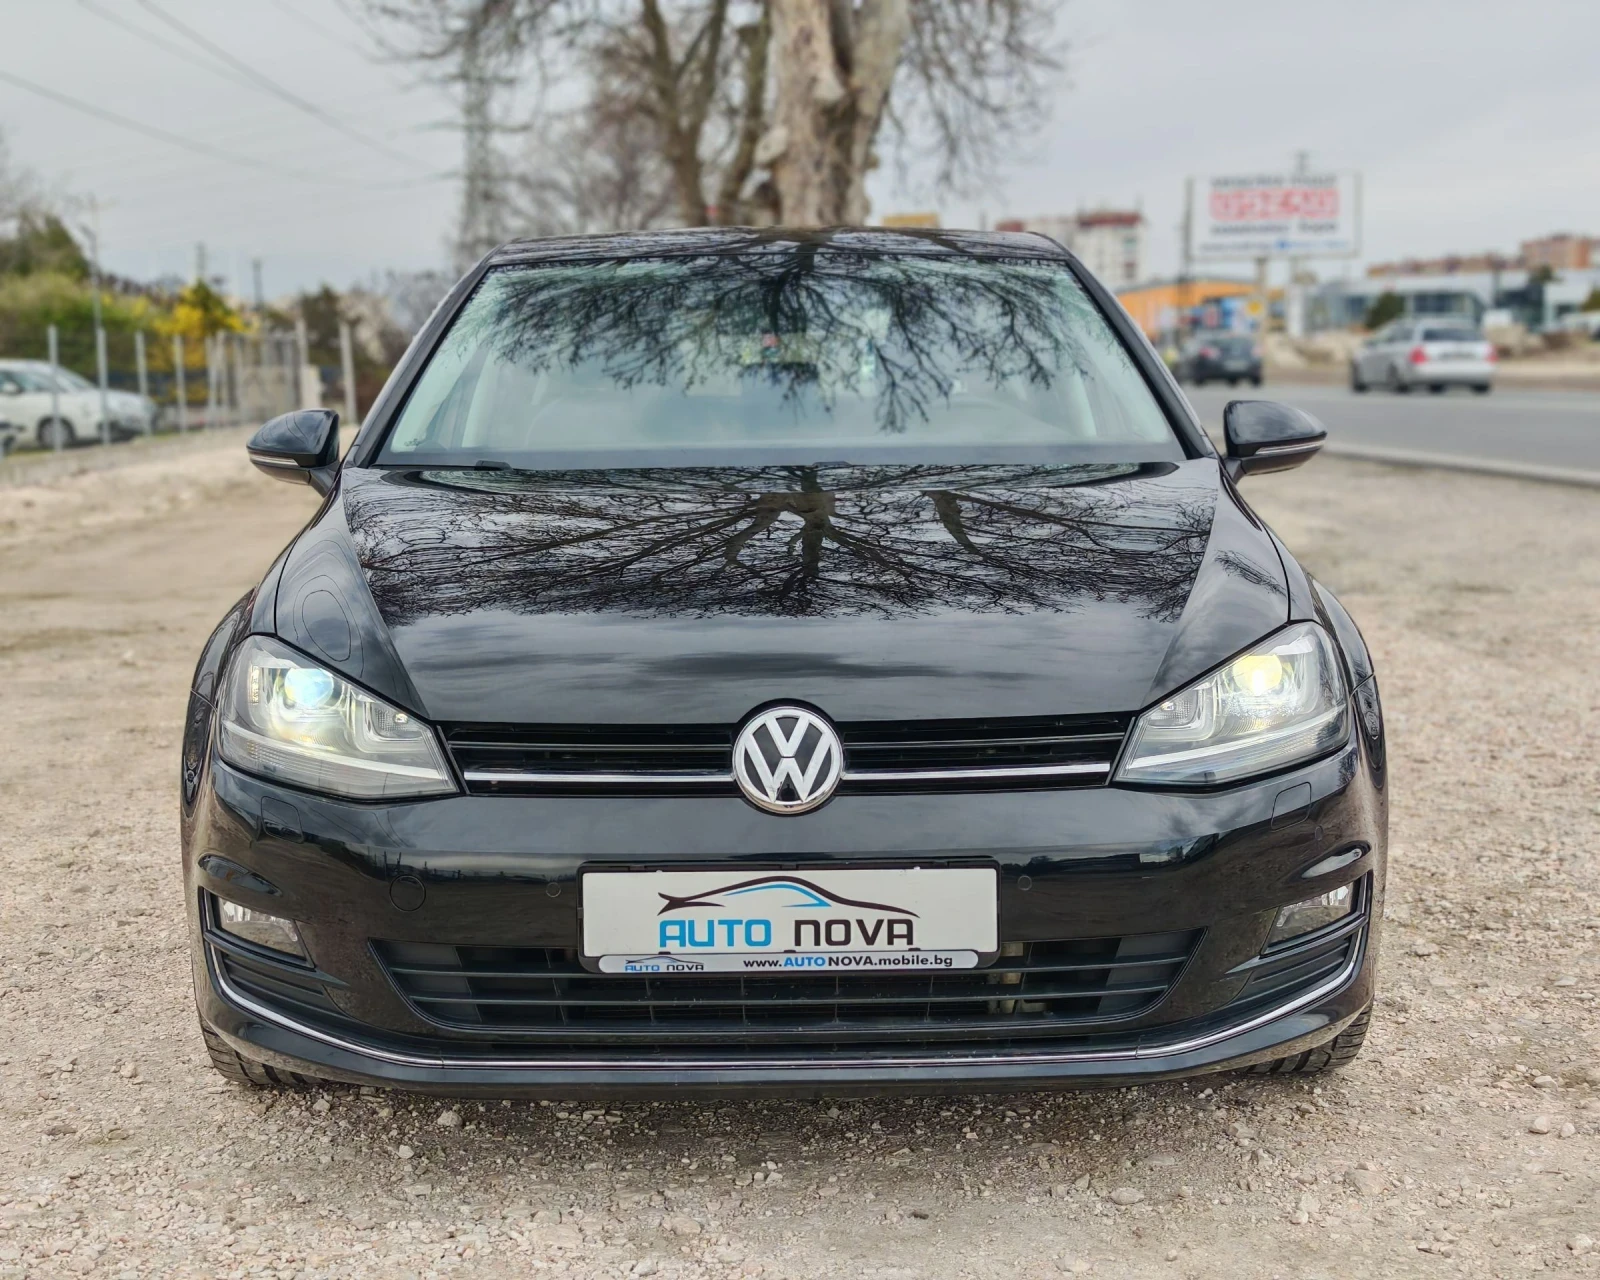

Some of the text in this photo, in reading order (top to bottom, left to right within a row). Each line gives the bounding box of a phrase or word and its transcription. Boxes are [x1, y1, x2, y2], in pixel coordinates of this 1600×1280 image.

[659, 918, 914, 948] AUTO NOVA
[624, 964, 660, 972] AUTO
